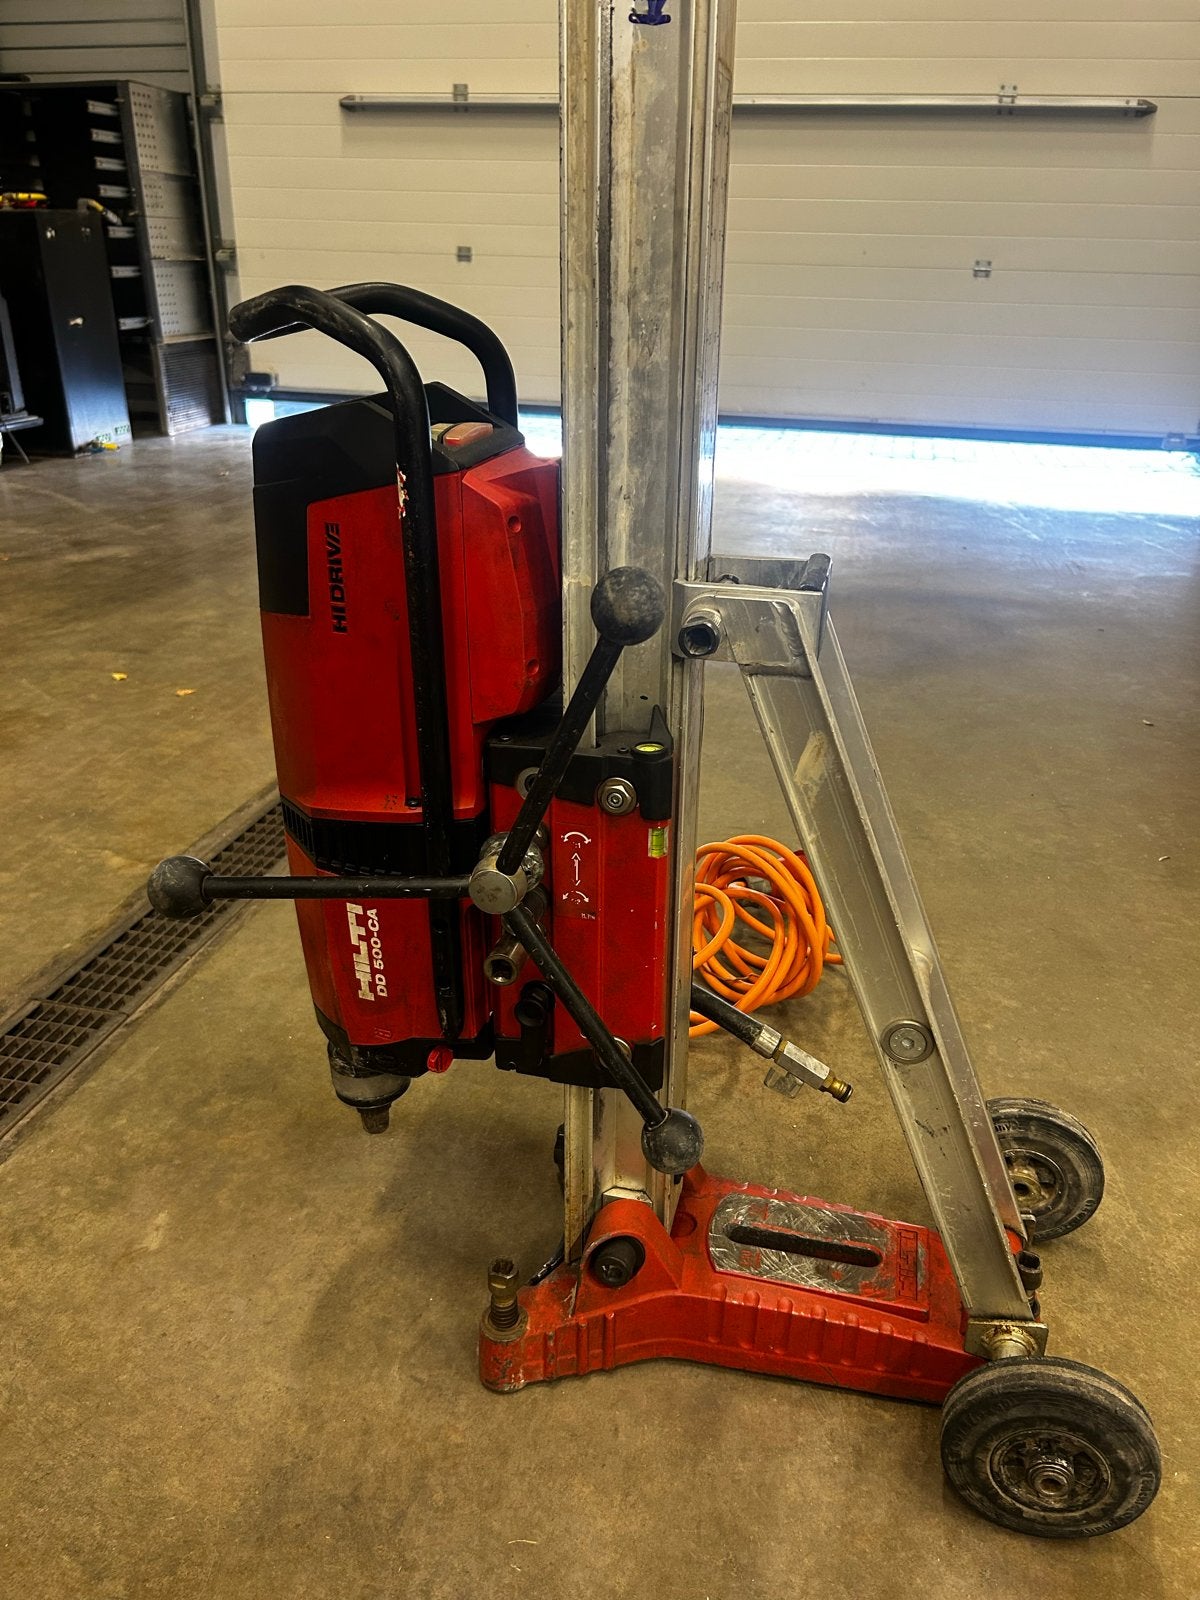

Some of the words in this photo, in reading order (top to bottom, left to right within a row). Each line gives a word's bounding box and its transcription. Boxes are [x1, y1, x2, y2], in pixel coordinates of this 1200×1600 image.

[346, 902, 375, 1001] HILTI
[366, 908, 384, 970] 500-CA
[375, 973, 388, 997] DD
